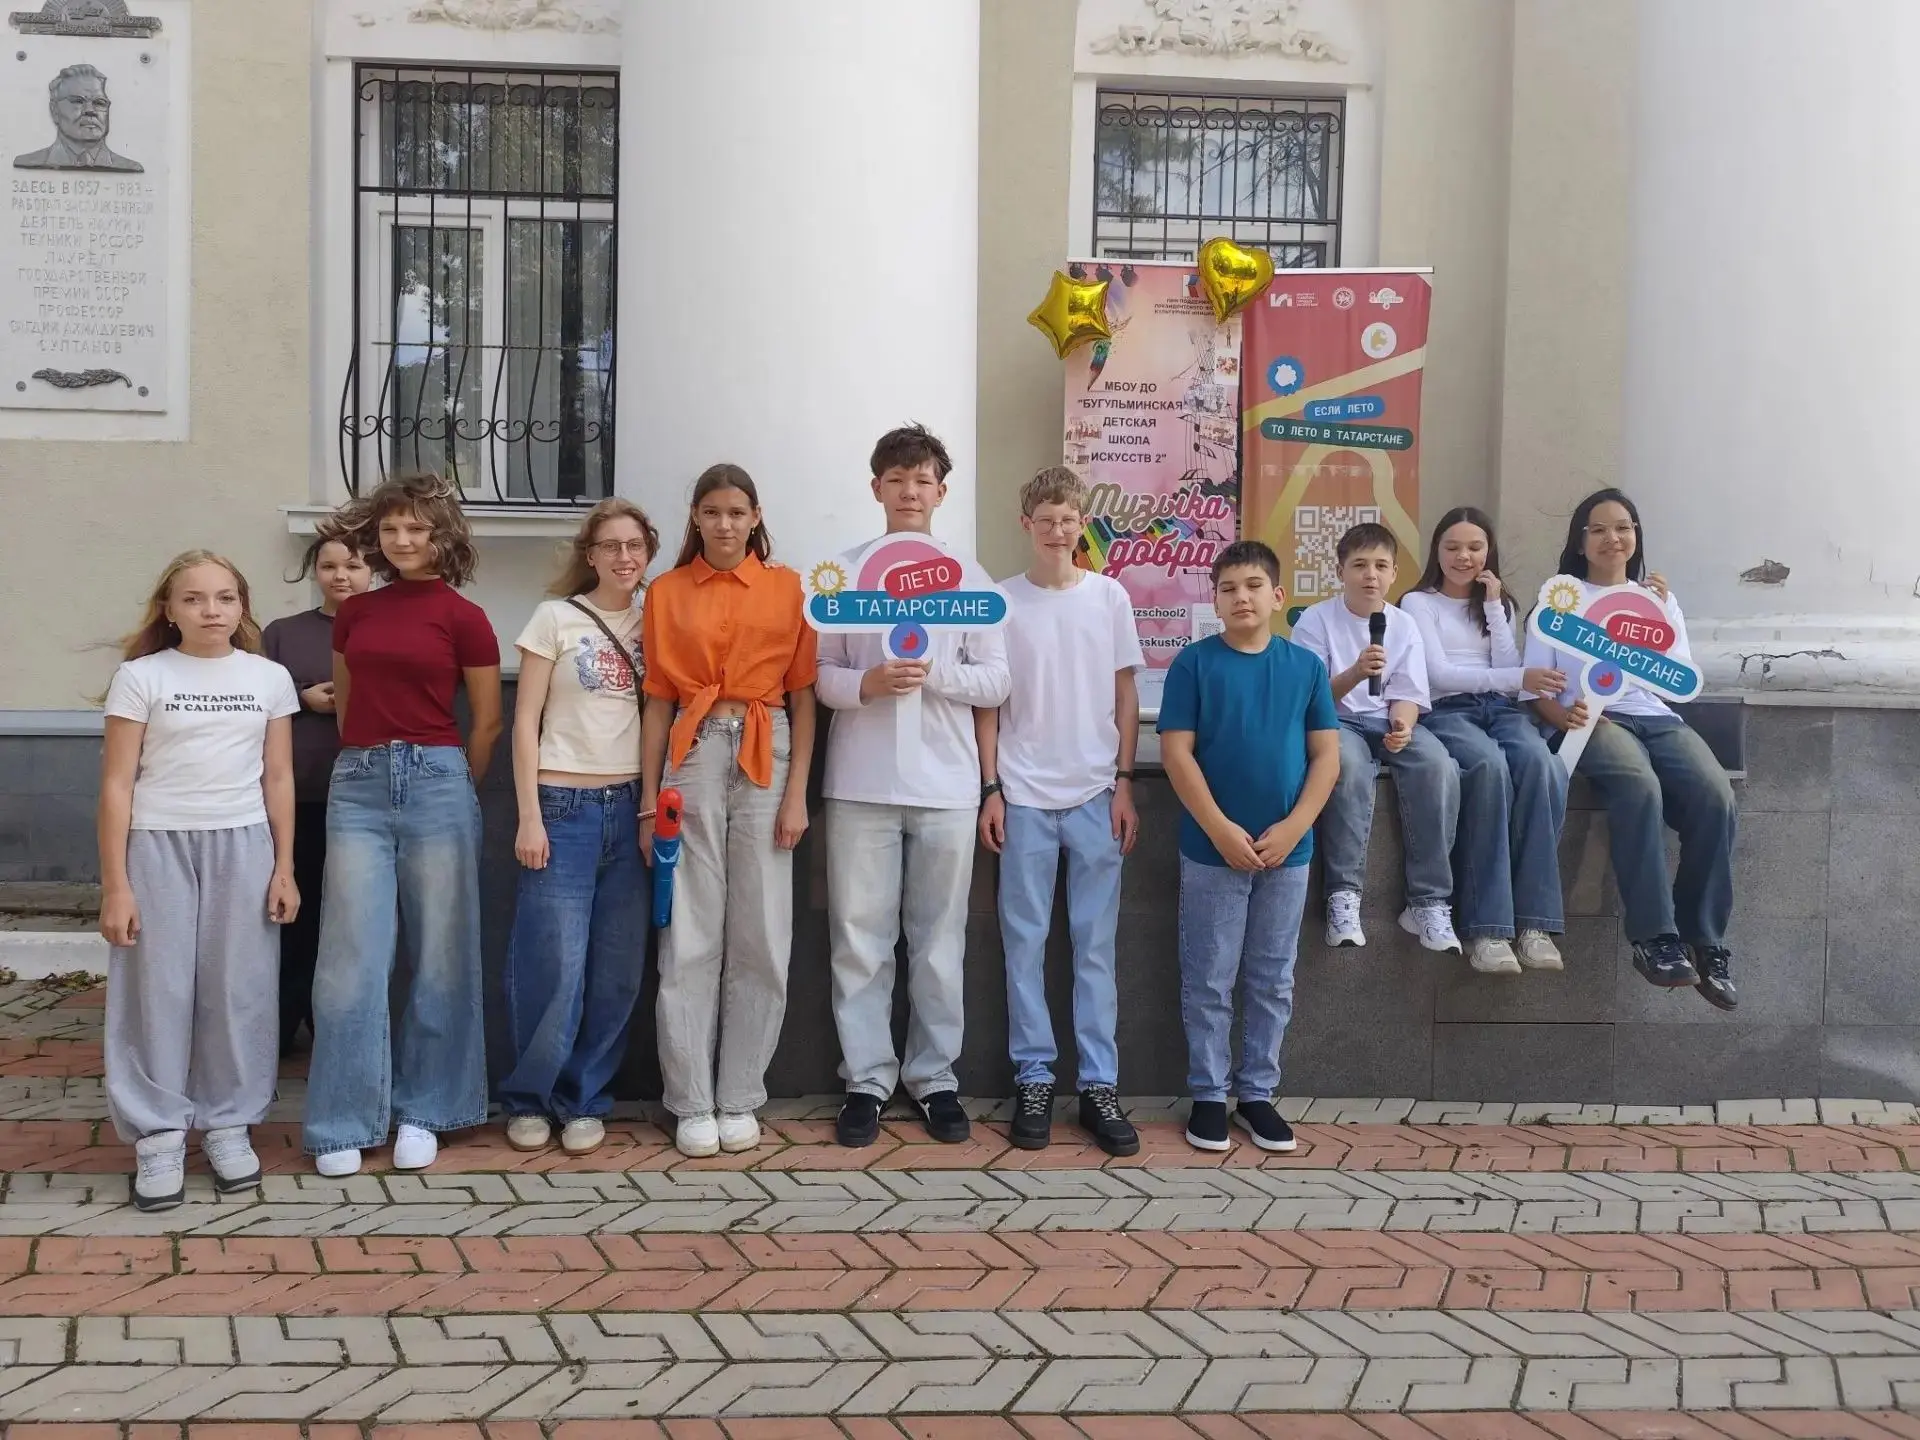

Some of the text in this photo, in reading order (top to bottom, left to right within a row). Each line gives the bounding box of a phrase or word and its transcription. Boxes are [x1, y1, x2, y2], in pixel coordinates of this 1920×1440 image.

[12, 180, 55, 193] ЗДЕСЬ
[62, 181, 70, 194] В
[20, 215, 83, 230] ДЕЯТЕЛЬ
[20, 233, 144, 249] ТЕХНИКИ РСФСР
[45, 251, 117, 265] ЛАУРЕАТ
[18, 268, 147, 285] ГОСУДАРСТВЕННОЙ
[33, 286, 130, 301] ПРЕМИИ СССР
[39, 304, 124, 319] ПРОФЕССОР
[1104, 381, 1157, 394] МБОУ ДО
[1314, 402, 1375, 417] ЕСЛИ ЛЕТО
[1103, 416, 1157, 428] ДЕТСКАЯ
[1108, 434, 1150, 446] ШКОЛА
[1271, 424, 1404, 445] ТО ЛЕТО В ТАТАРСТАНЕ
[1090, 452, 1167, 464] ИСКУССТВ 2"
[1088, 482, 1231, 532] Музыка
[1101, 528, 1218, 579] добра
[898, 565, 950, 592] ЛЕТО
[827, 599, 989, 617] В ТАТАРСТАНЕ
[1616, 621, 1665, 644] ЛЕТО
[1549, 615, 1686, 688] В ТАТАРСТАНЕ
[173, 693, 255, 702] SUNTANNED
[165, 703, 263, 712] IN CALIFORNIA
